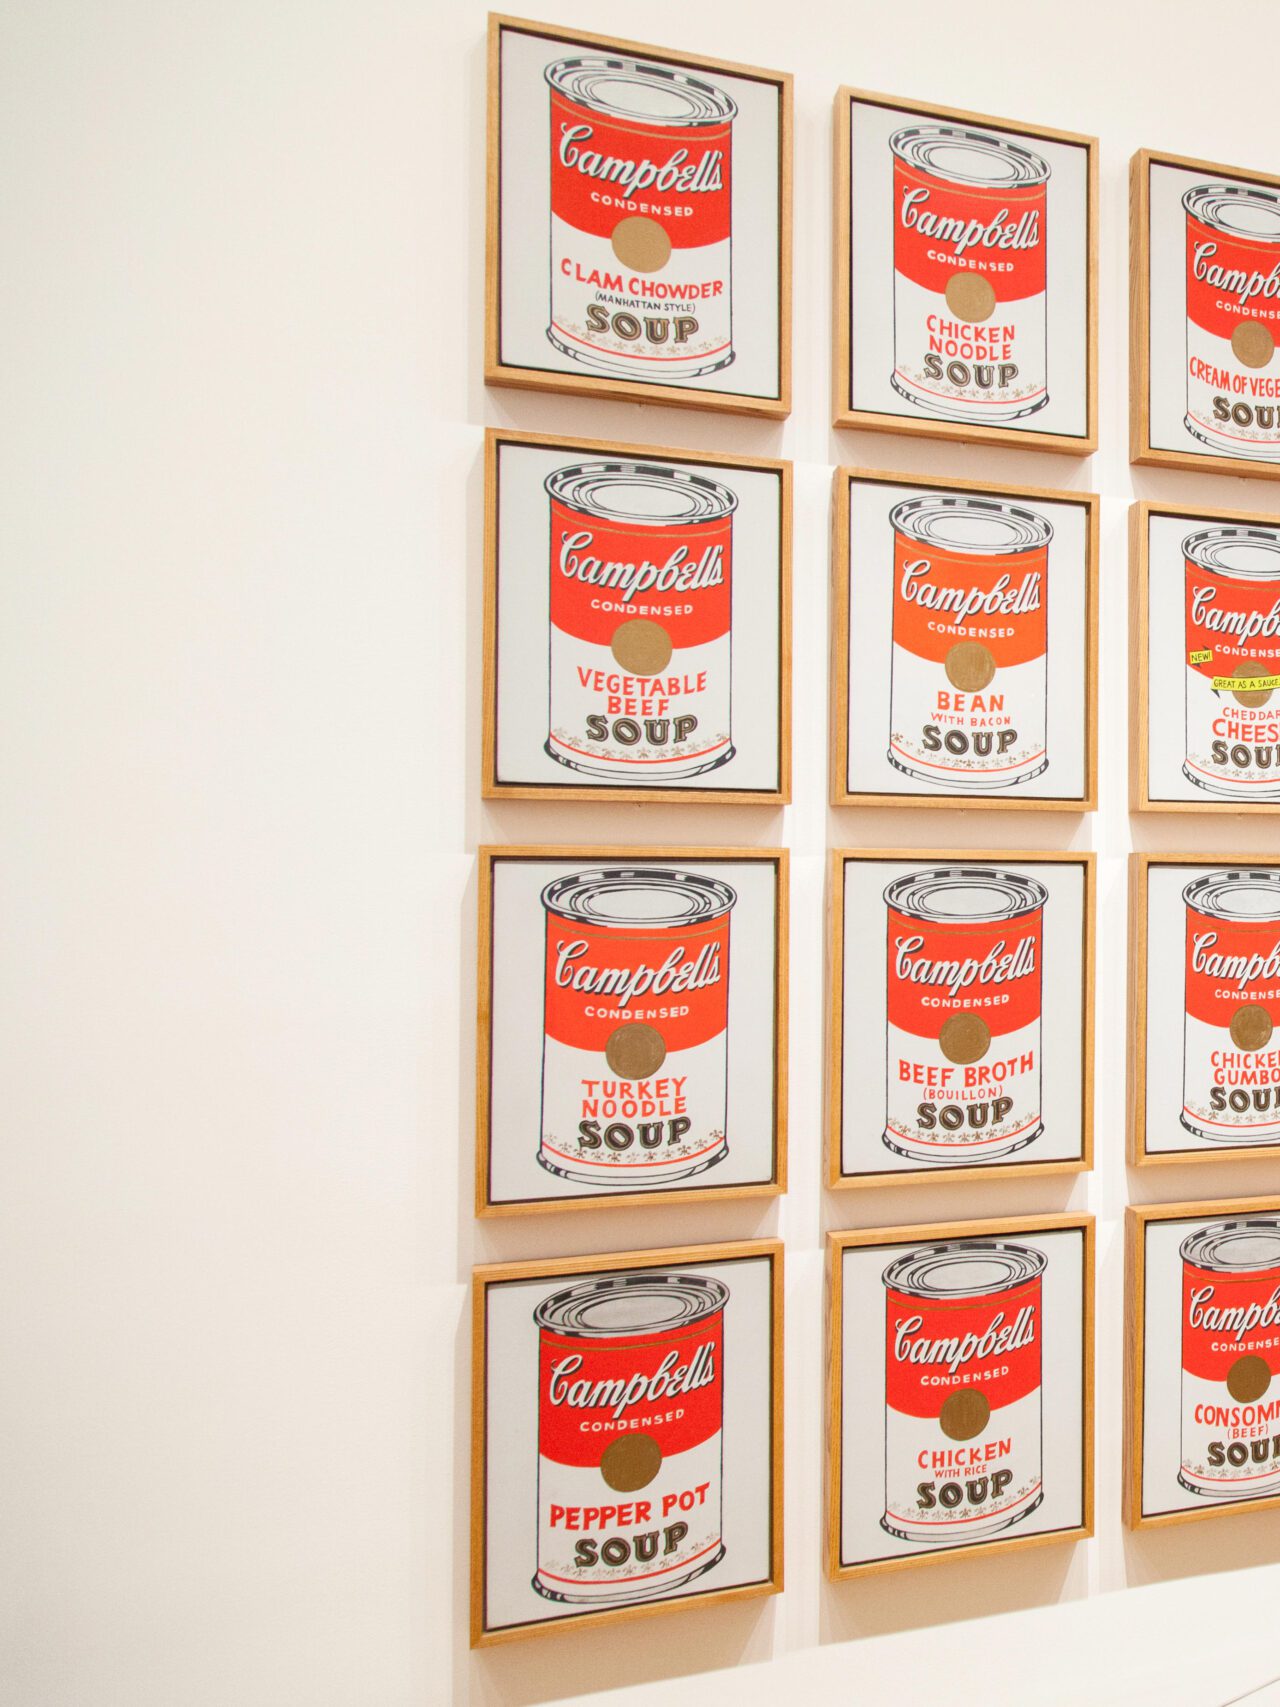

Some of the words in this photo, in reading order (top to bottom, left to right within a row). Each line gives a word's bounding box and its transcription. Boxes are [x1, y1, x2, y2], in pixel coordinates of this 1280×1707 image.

[559, 122, 724, 198] Campbell's
[590, 192, 694, 217] CONDENSED
[902, 186, 1040, 255] Campbell's
[927, 250, 1014, 271] CONDENSED
[560, 258, 624, 292] CLAM
[628, 277, 723, 300] CHOWDER
[595, 292, 661, 310] (MANHATTAN
[664, 302, 696, 314] STYLE)
[585, 303, 699, 344] SOUP
[927, 315, 1015, 342] CHICKEN
[929, 335, 1012, 361] NOODLE
[923, 353, 1019, 389] SOUP
[1189, 356, 1231, 391] CREAM
[1233, 375, 1247, 394] OF
[559, 531, 724, 604] Campbell's
[591, 599, 694, 616] CONDENSED
[902, 560, 1041, 625] Campbell's
[928, 621, 1015, 638] CONDENSED
[1191, 651, 1211, 662] NEW!
[577, 666, 707, 698] VEGETABLE
[1213, 678, 1235, 688] GREAT
[1238, 681, 1247, 689] AS
[608, 695, 669, 717] BEEF
[937, 690, 1005, 713] BEAN
[586, 714, 698, 746] SOUP
[931, 712, 964, 725] WITH
[971, 716, 1011, 727] BACON
[922, 725, 1018, 756] SOUP
[555, 939, 721, 1008] Campbell's
[896, 935, 1036, 997] Campbell's
[584, 1005, 689, 1020] CONDENSED
[921, 993, 1010, 1008] CONDENSED
[899, 1059, 955, 1088] BEEF
[964, 1050, 1034, 1088] BROTH
[581, 1076, 687, 1100] TURKEY
[923, 1084, 1004, 1101] (BOUILLON)
[582, 1096, 687, 1119] NOODLE
[917, 1096, 1014, 1130] SOUP
[577, 1116, 691, 1151] SOUP
[894, 1305, 1035, 1374] Campbell's
[549, 1341, 715, 1419] Campbell's
[920, 1365, 1009, 1386] CONDENSED
[580, 1408, 685, 1432] CONDENSED
[1227, 1425, 1269, 1440] (BEEF)
[918, 1437, 1012, 1469] CHICKEN
[934, 1467, 963, 1478] WITH
[964, 1463, 987, 1477] RICE
[916, 1468, 1013, 1509] SOUP
[549, 1500, 651, 1530] PEPPER
[662, 1481, 711, 1518] POT
[573, 1521, 688, 1567] SOUP
